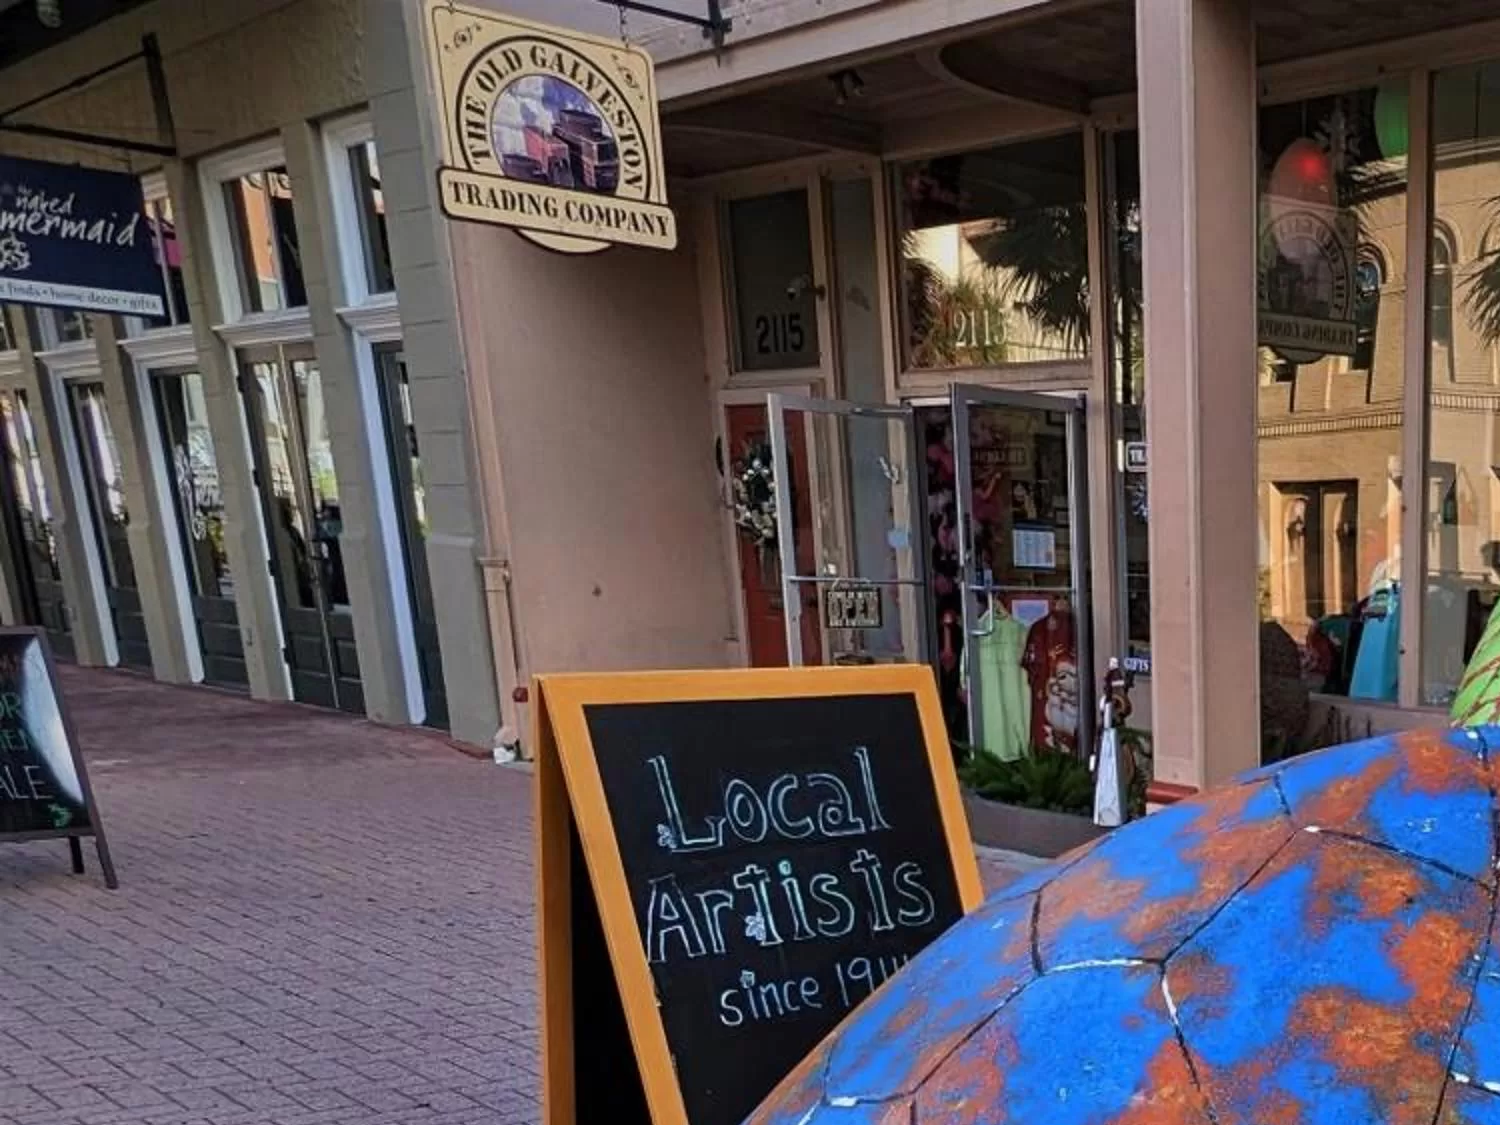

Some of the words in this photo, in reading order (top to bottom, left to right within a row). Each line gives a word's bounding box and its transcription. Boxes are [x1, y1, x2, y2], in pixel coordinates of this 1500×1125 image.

[475, 47, 523, 93] OLD
[465, 95, 491, 165] THE
[530, 45, 643, 192] GALVESTON
[16, 191, 75, 214] naked
[448, 180, 560, 219] TRADING
[565, 200, 670, 237] COMPANY
[0, 211, 141, 247] mermaid
[755, 312, 804, 355] 2115
[954, 308, 1008, 348] 2115
[828, 598, 879, 620] OPEN
[647, 746, 894, 853] Local
[720, 969, 823, 1026] since
